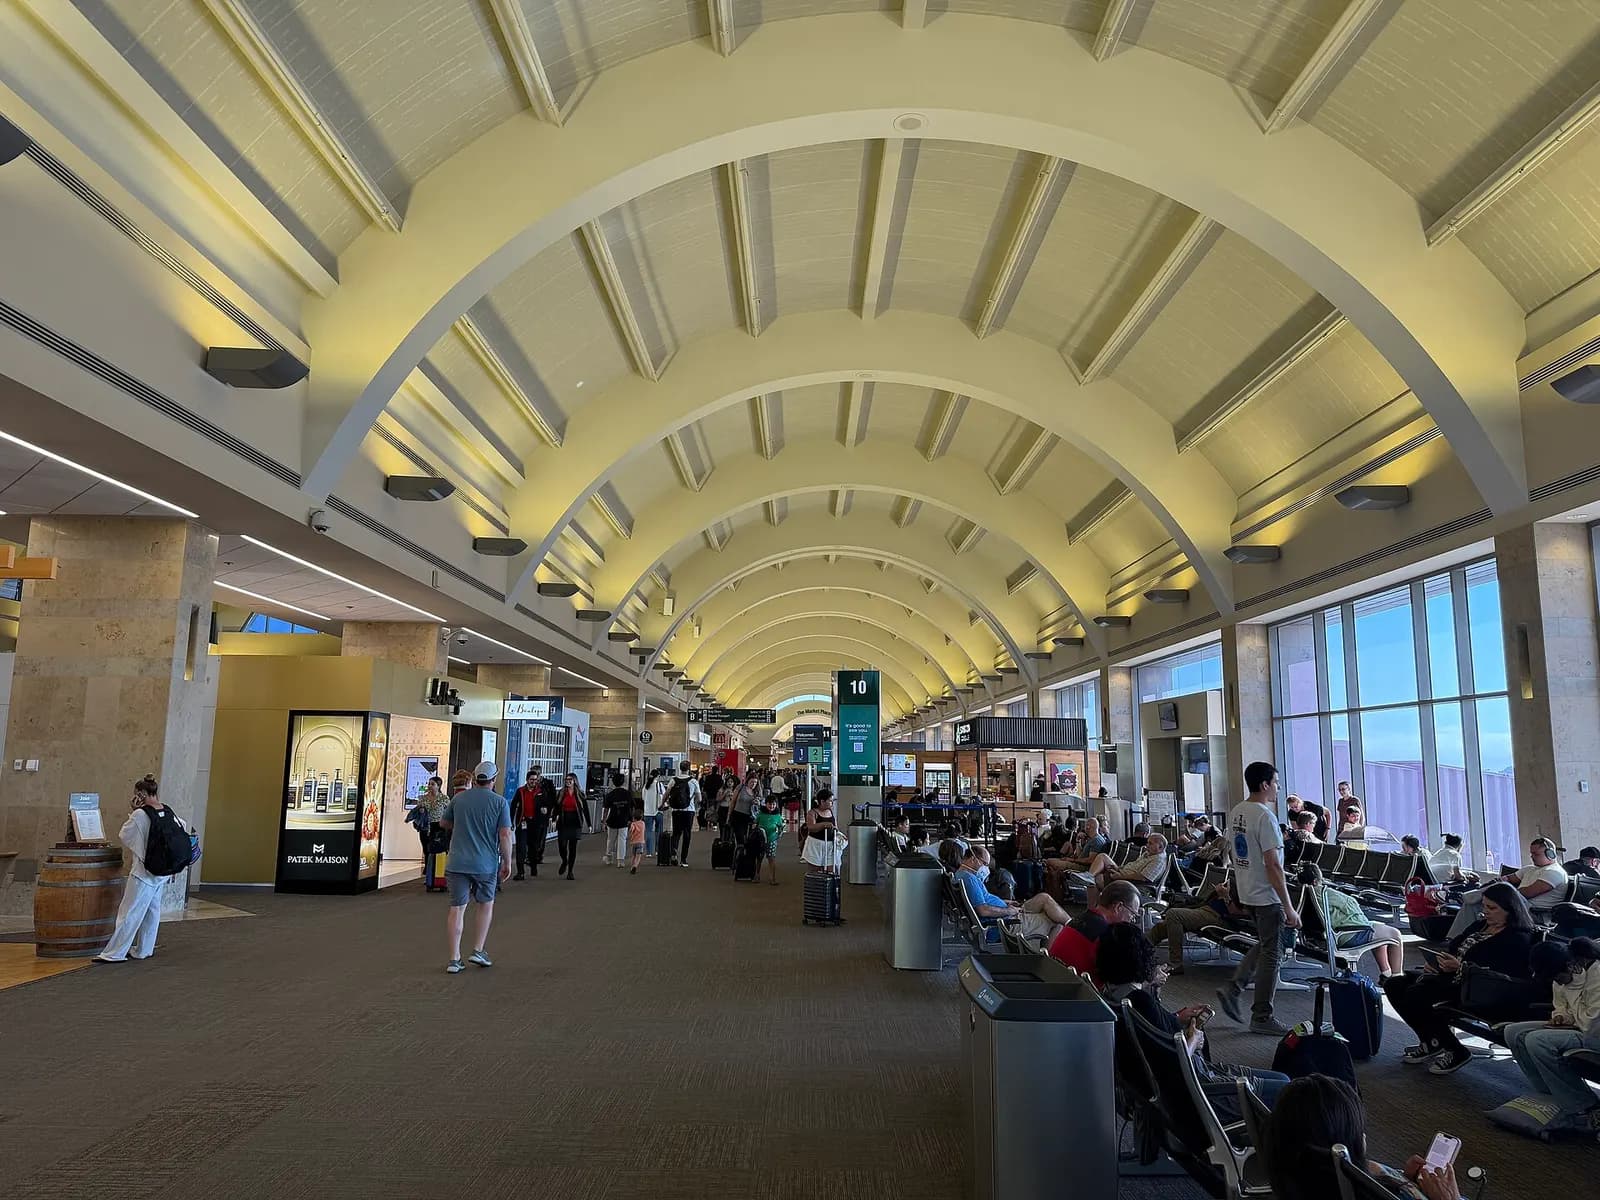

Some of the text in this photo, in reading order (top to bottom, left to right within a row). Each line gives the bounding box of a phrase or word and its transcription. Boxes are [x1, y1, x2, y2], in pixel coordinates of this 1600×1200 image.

[850, 680, 867, 695] 10
[823, 730, 830, 738] 11
[799, 748, 819, 756] 1 2
[287, 855, 349, 864] PATEK MAISON
